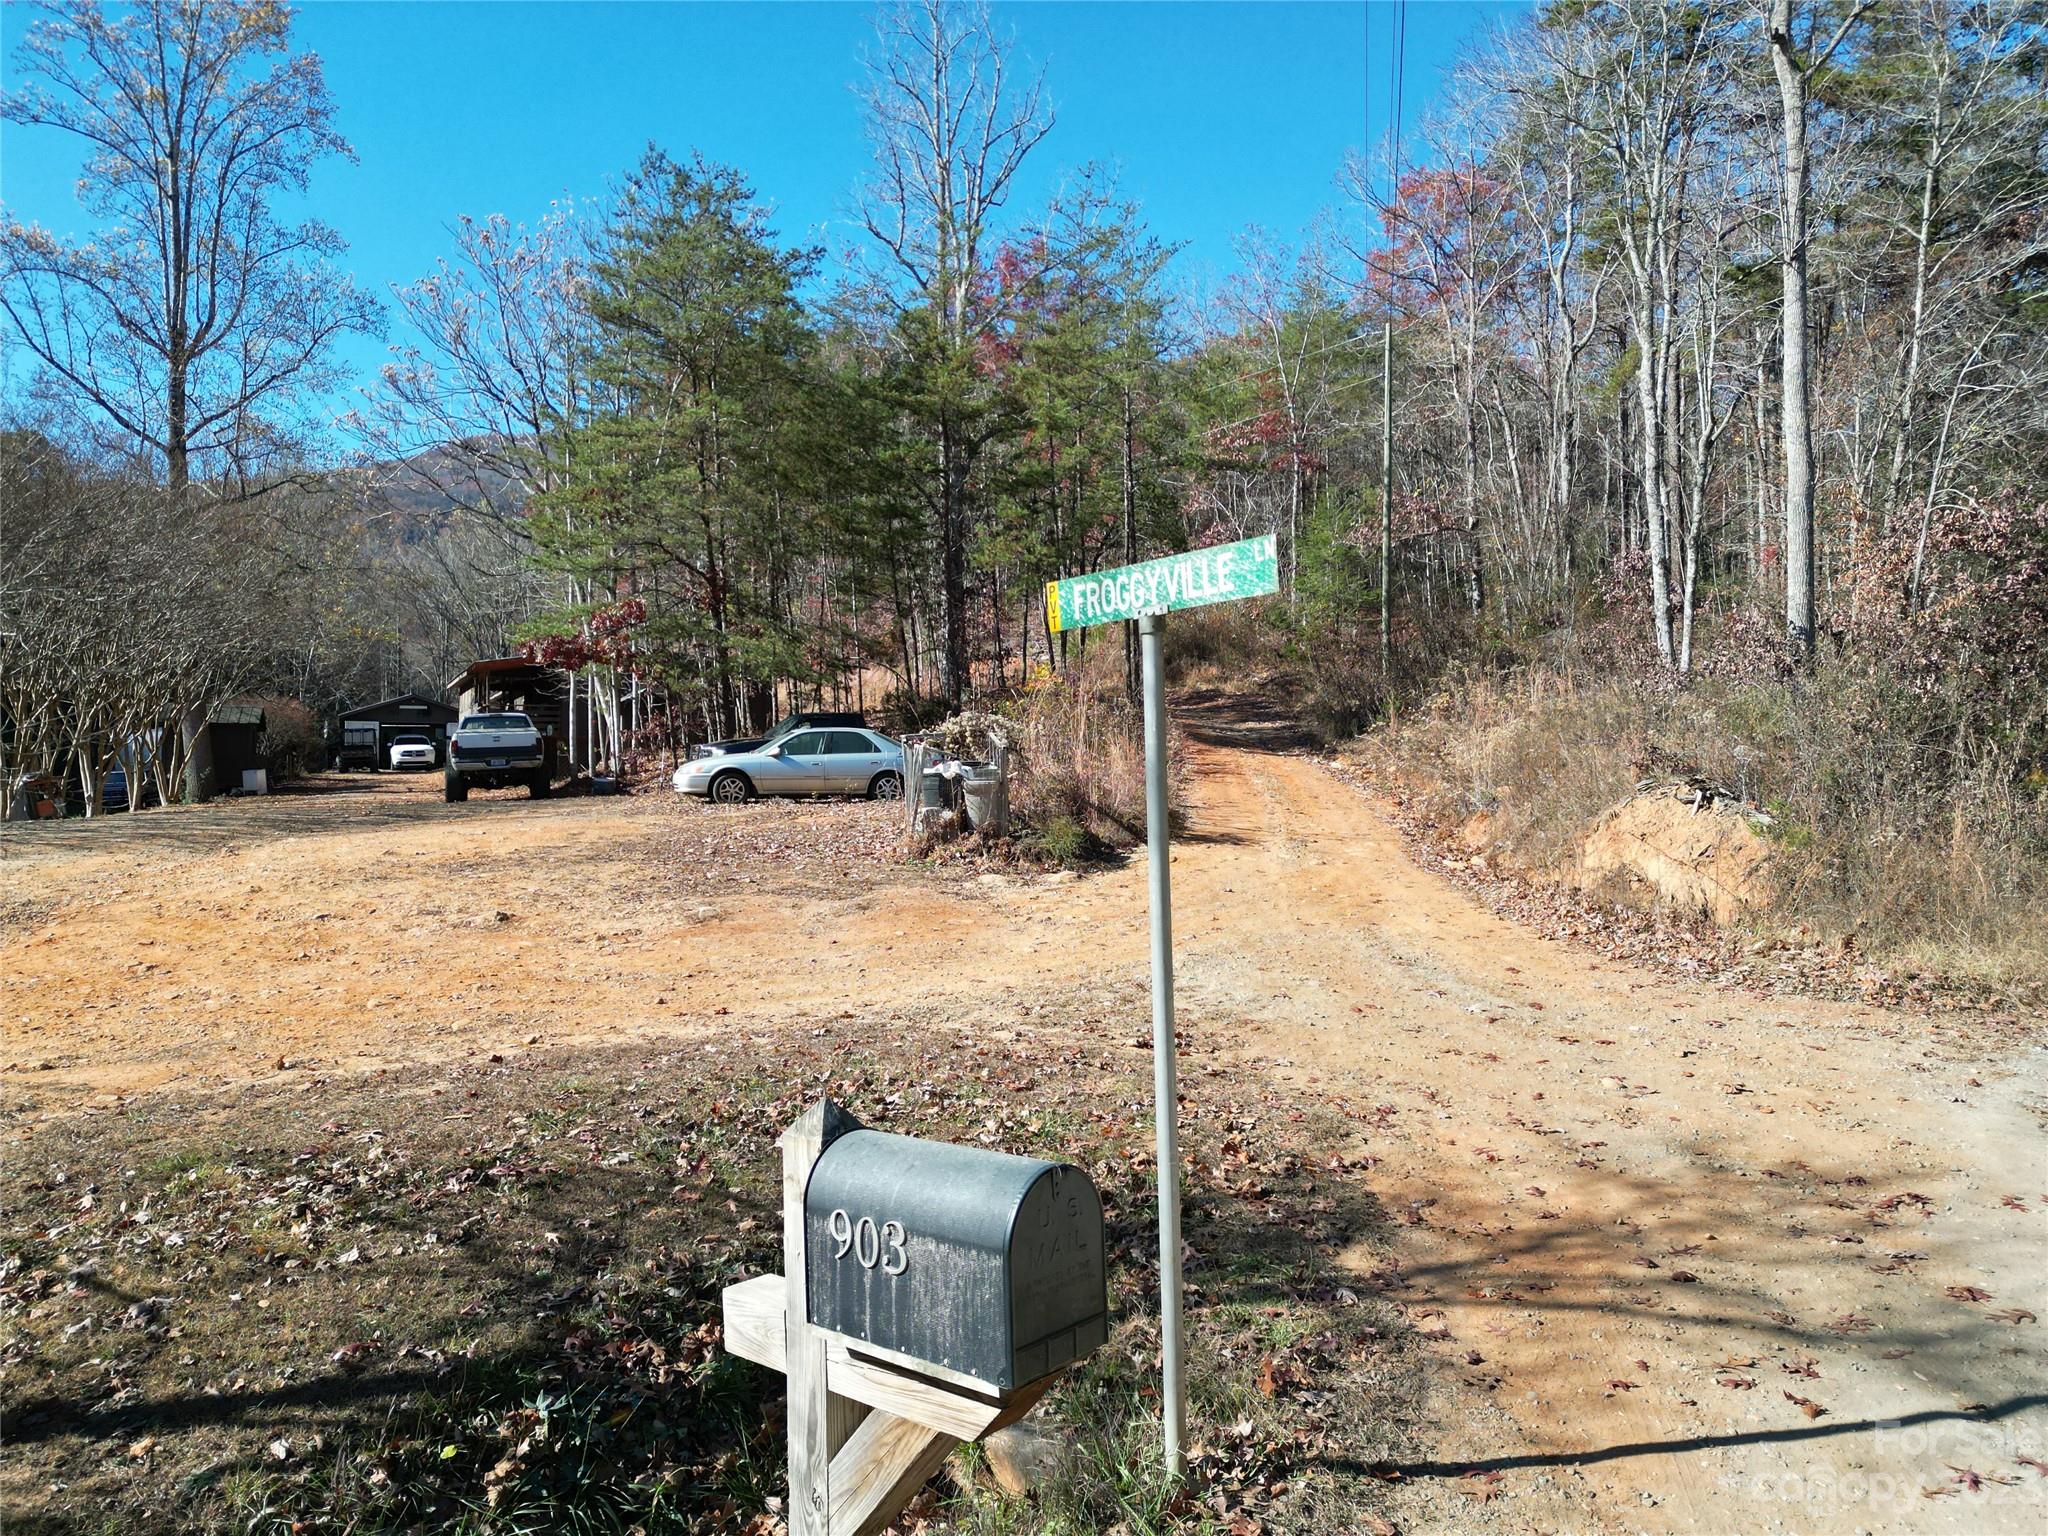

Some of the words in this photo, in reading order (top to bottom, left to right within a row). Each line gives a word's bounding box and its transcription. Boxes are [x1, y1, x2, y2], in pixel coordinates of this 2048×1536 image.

[1072, 551, 1236, 619] FROGGYVILLE
[1253, 537, 1278, 562] LN
[1047, 585, 1060, 629] PVT
[829, 1208, 909, 1276] 903
[1030, 1229, 1089, 1269] MAIL
